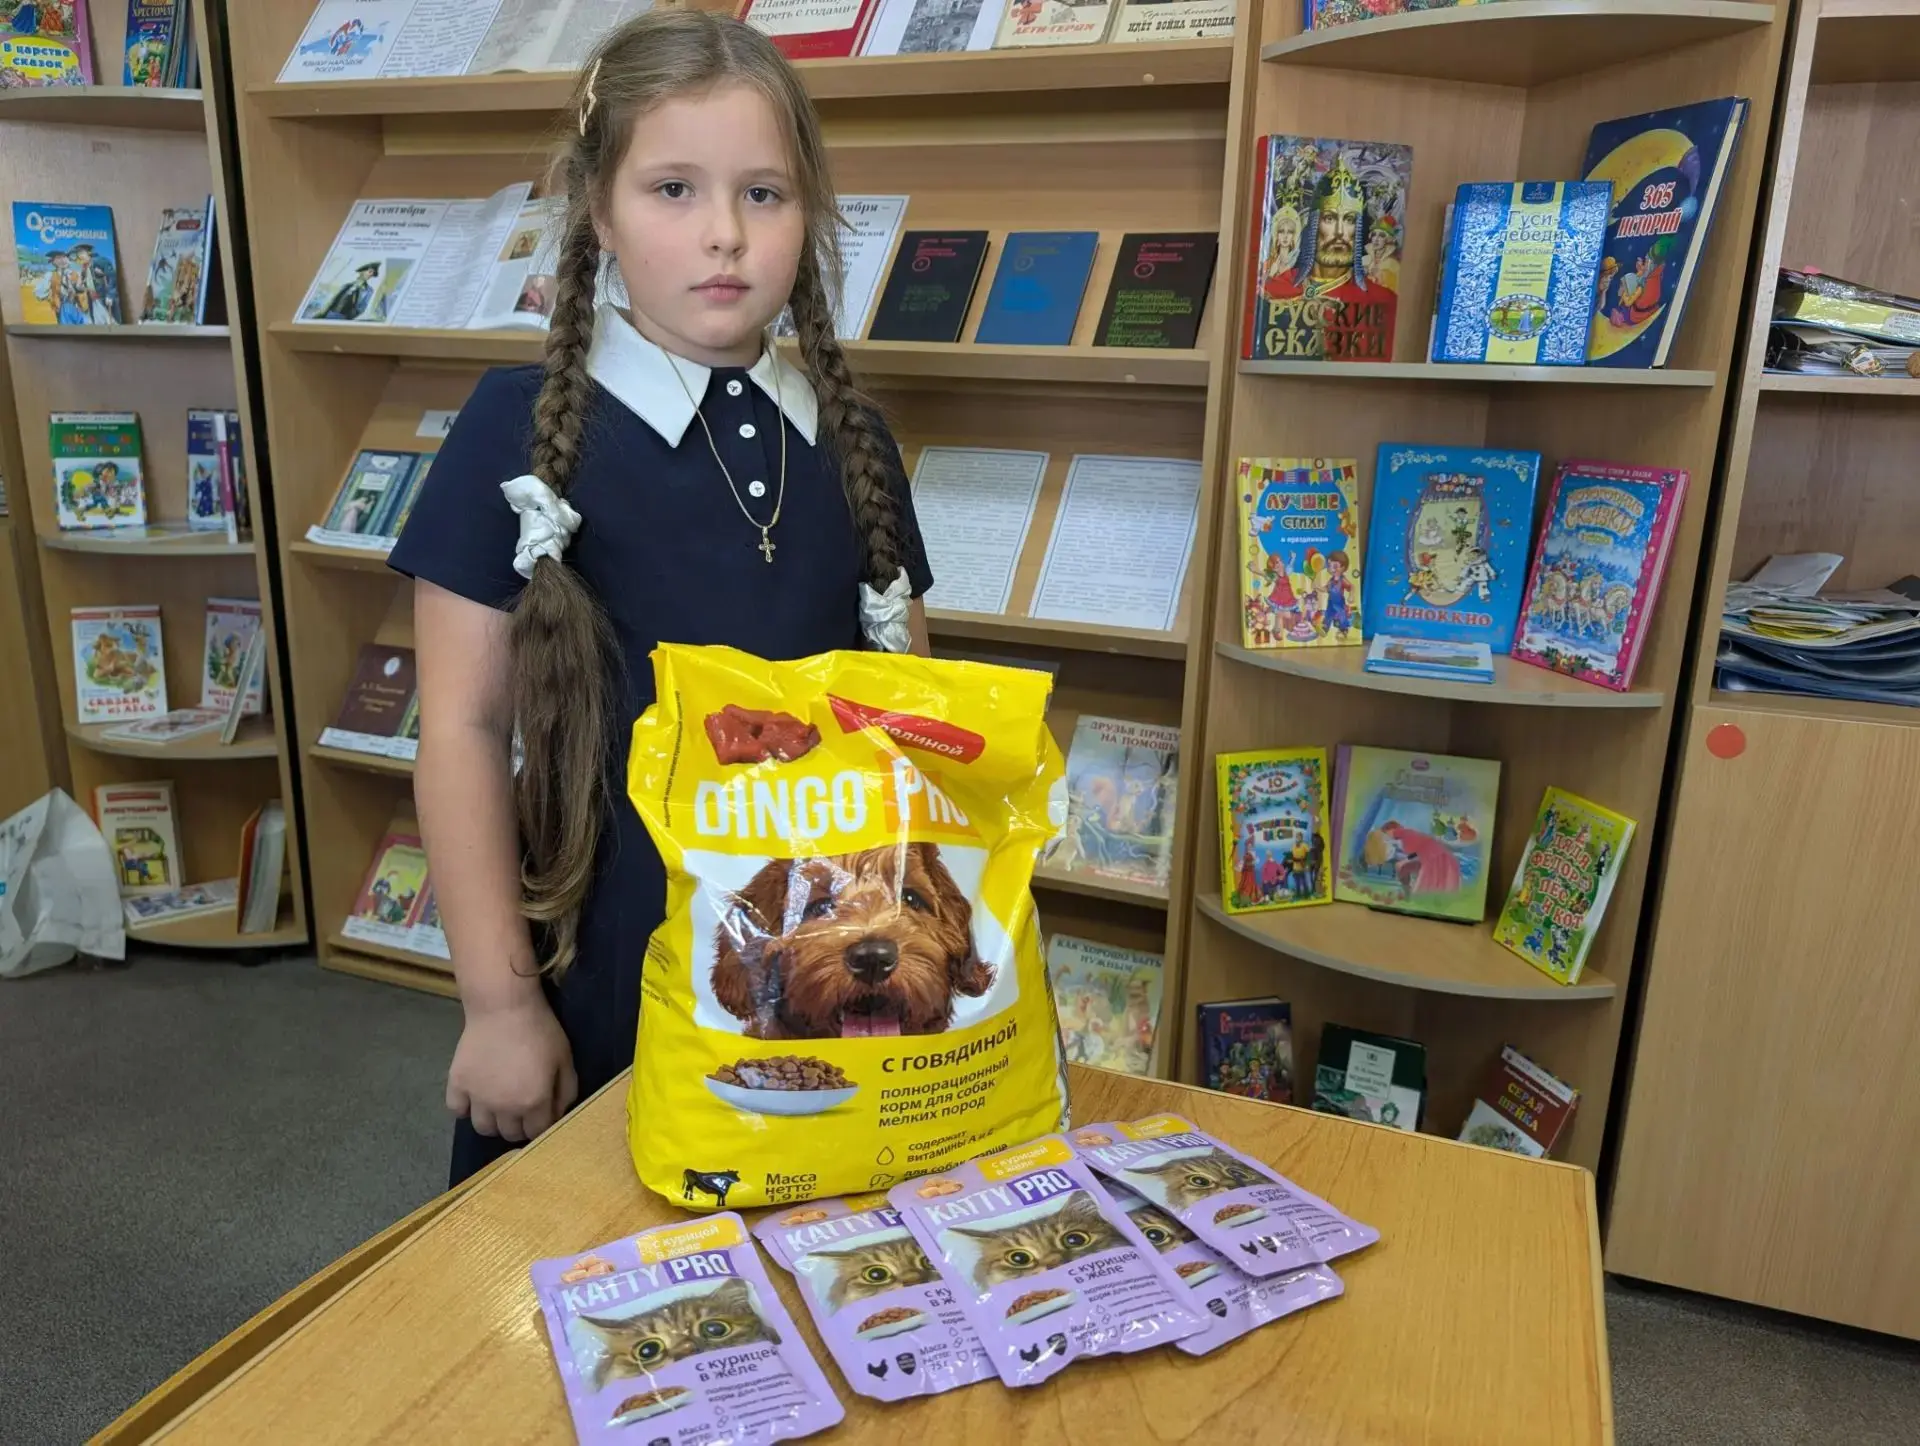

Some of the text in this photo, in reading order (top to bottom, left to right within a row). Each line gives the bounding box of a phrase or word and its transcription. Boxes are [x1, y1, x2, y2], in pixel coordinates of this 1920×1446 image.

[1155, 18, 1186, 30] ВОЙНА
[3, 42, 71, 58] В царстве
[12, 57, 63, 69] сказок
[1639, 181, 1677, 211] 365
[1506, 210, 1560, 230] Гуси-
[1616, 208, 1684, 239] ИСТОРИЙ
[1497, 227, 1566, 244] лебеди
[1267, 299, 1388, 330] РУССКИЕ
[1264, 327, 1387, 358] СКАЗКИ
[1265, 492, 1341, 512] ЛУЧШИЕ
[1281, 514, 1328, 530] СТИХИ
[1386, 604, 1493, 627] ПИНОККИО
[1090, 720, 1181, 742] ДРУЗЬЯ ПРИДУ
[1100, 733, 1118, 743] НА
[694, 769, 868, 841] DINGO
[1552, 906, 1584, 930] КОТ
[880, 1054, 1009, 1100] полнорационный
[879, 1077, 996, 1115] корм для собак
[878, 1095, 986, 1128] мелких пород
[907, 1138, 966, 1163] витамины
[908, 1130, 967, 1151] содержит
[1091, 1139, 1169, 1166] KATTY
[765, 1183, 817, 1196] нетто:
[766, 1172, 817, 1186] Масса
[768, 1192, 812, 1203] 1,9 кг
[924, 1186, 1014, 1227] KATTY
[1013, 1170, 1074, 1202] PRO
[662, 1224, 720, 1249] курицей
[785, 1213, 875, 1252] KATTY
[1068, 1251, 1141, 1277] с курицей
[561, 1253, 732, 1313] KATTY PRO
[1074, 1265, 1124, 1285] в желе
[924, 1290, 933, 1298] с
[929, 1298, 940, 1308] в
[694, 1362, 705, 1372] с
[700, 1362, 759, 1382] в желе
[677, 1422, 711, 1438] Масса
